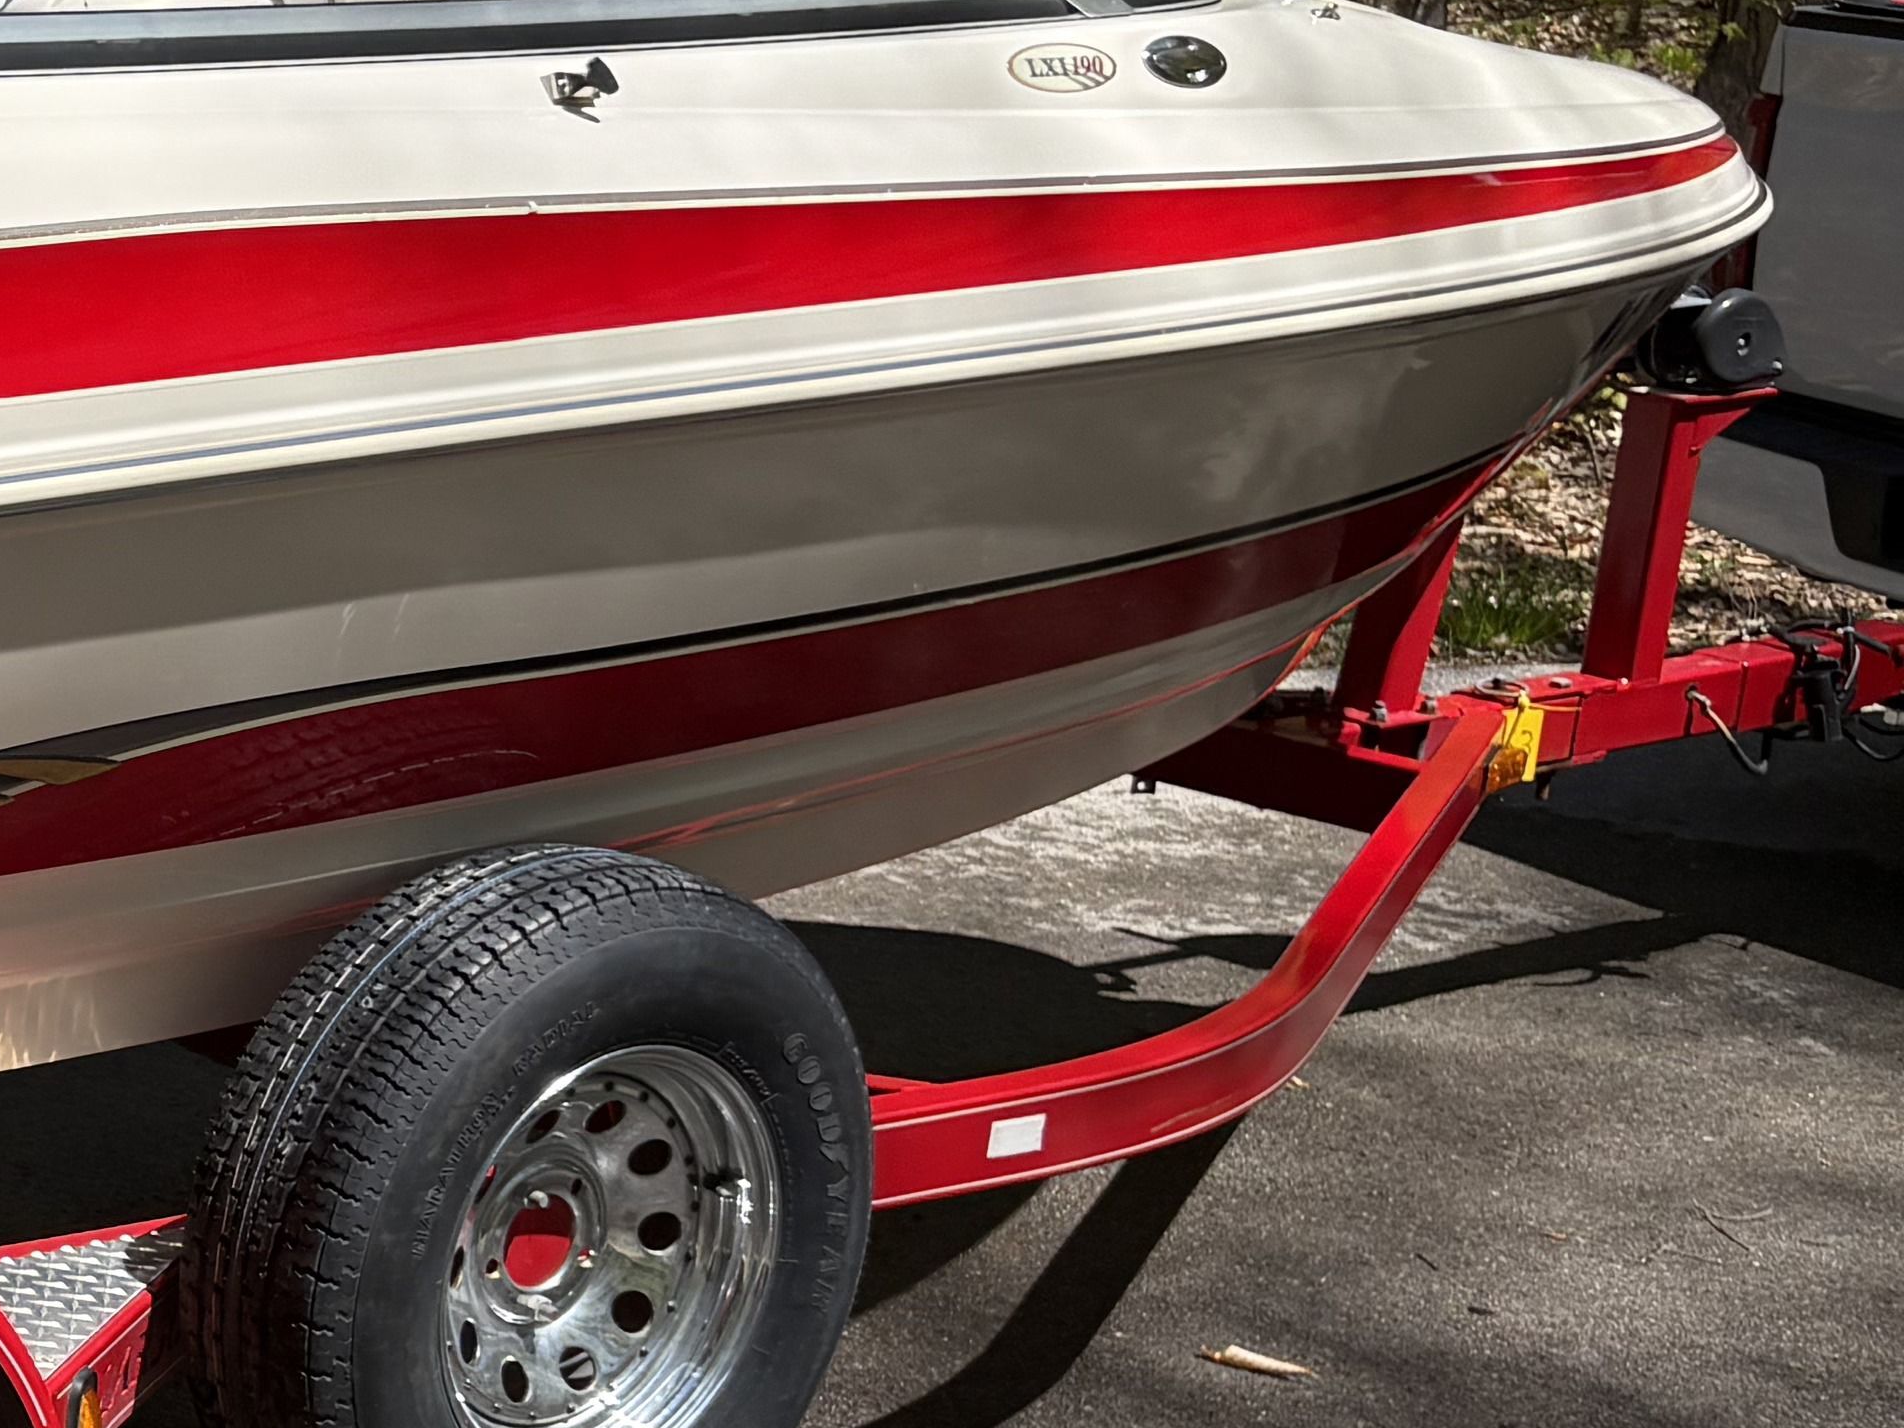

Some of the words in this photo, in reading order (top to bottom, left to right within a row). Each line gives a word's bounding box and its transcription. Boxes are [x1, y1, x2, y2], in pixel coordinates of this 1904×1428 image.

[1073, 55, 1105, 76] 190
[511, 1000, 600, 1078] RADIAL
[783, 1031, 850, 1315] GOODYEAR
